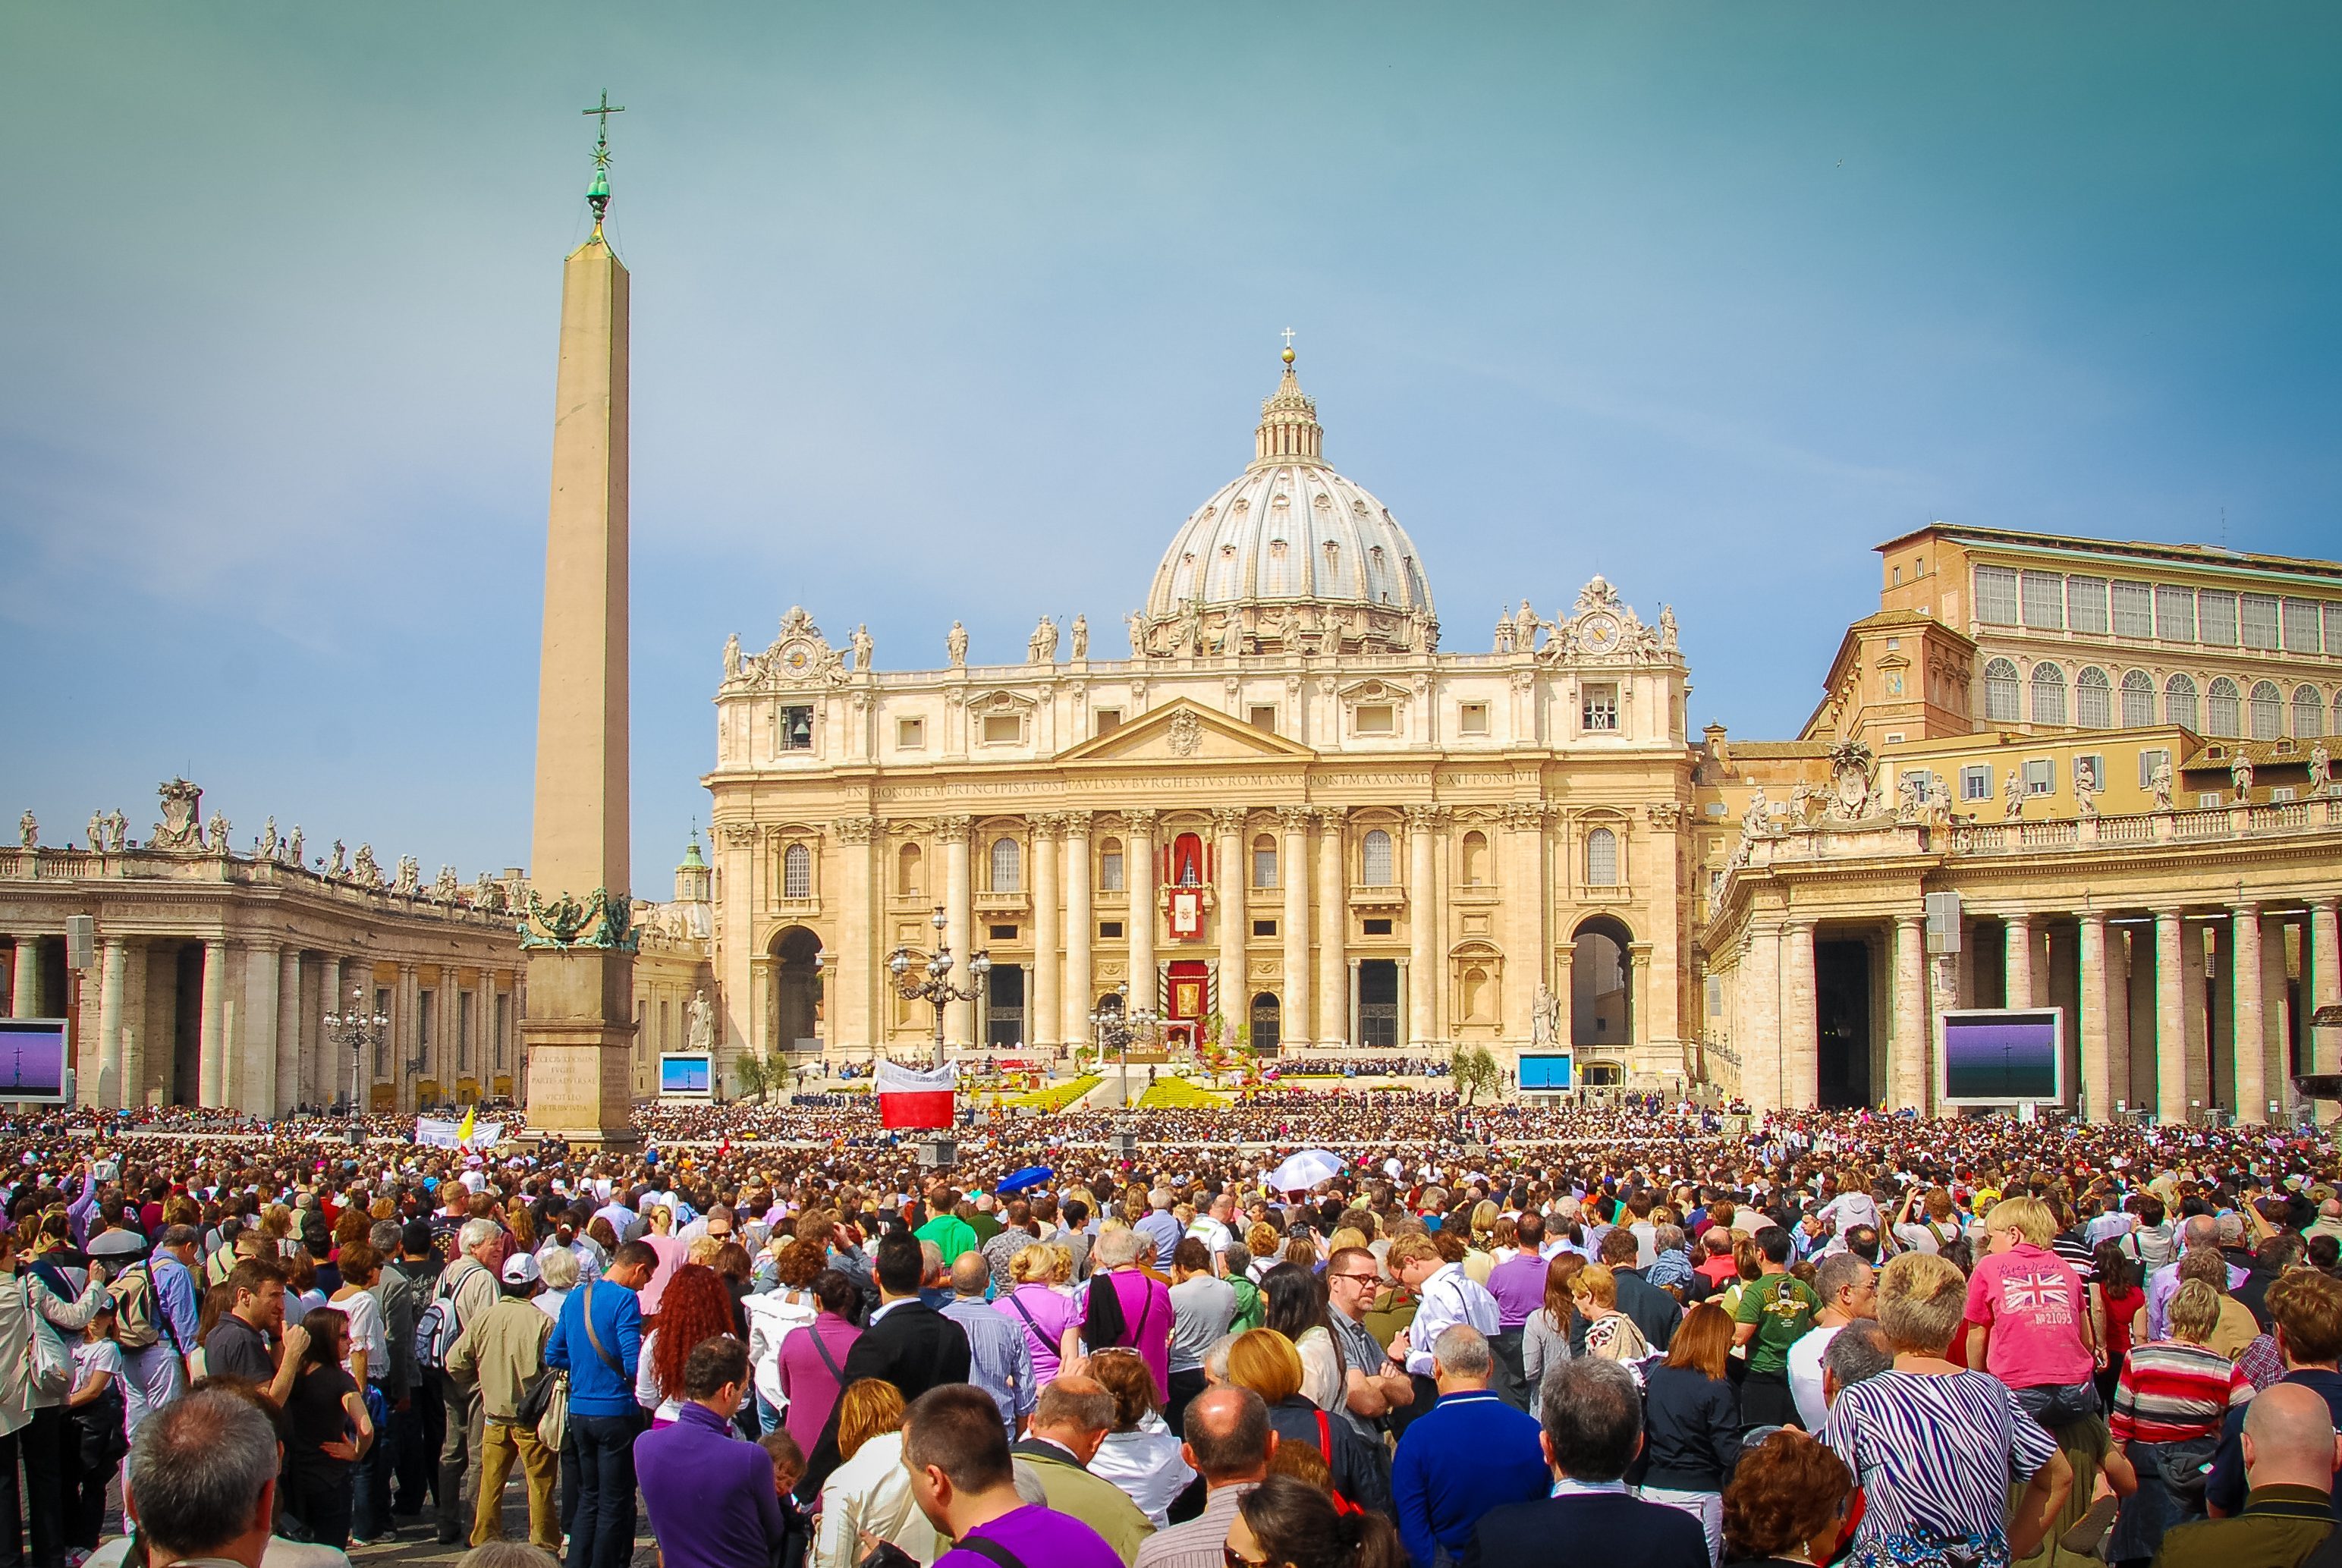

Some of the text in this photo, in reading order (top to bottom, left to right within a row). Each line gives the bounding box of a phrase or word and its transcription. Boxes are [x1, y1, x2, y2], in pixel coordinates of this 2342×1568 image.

[847, 786, 863, 797] IN
[872, 786, 945, 798] HONOREM
[947, 782, 1020, 795] PRINCIPIS
[1022, 781, 1066, 793] APOST
[1067, 778, 1116, 790] PAVLVS
[1131, 776, 1224, 788] BVRGHESIVS
[1228, 774, 1303, 786] ROMANVS
[1309, 774, 1347, 785] PONT
[1348, 774, 1381, 785] MAX
